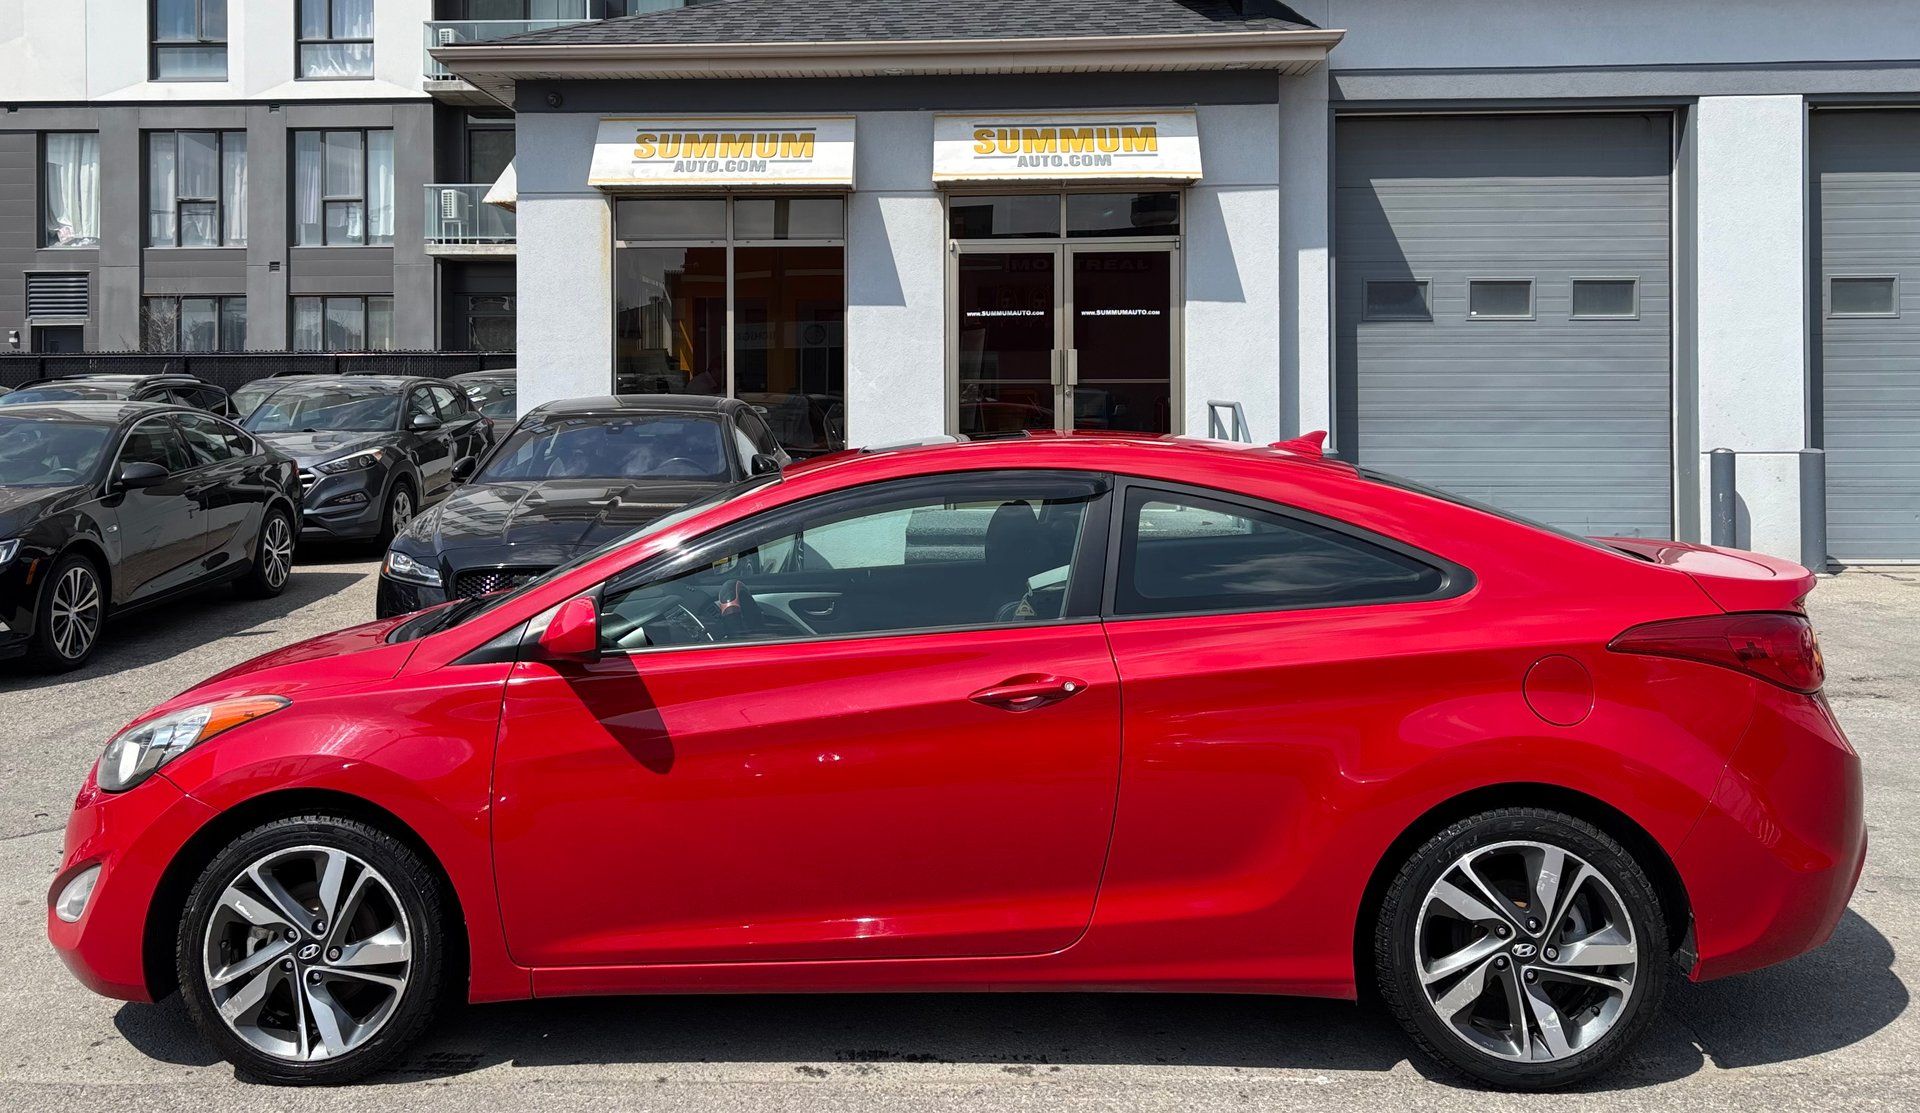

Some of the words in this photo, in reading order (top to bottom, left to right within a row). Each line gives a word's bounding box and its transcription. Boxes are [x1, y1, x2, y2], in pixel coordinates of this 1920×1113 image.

[633, 133, 816, 159] SUMMUM
[973, 127, 1158, 154] SUMMUM
[673, 159, 767, 173] AUTO.COM
[1016, 154, 1112, 168] AUTO.COM
